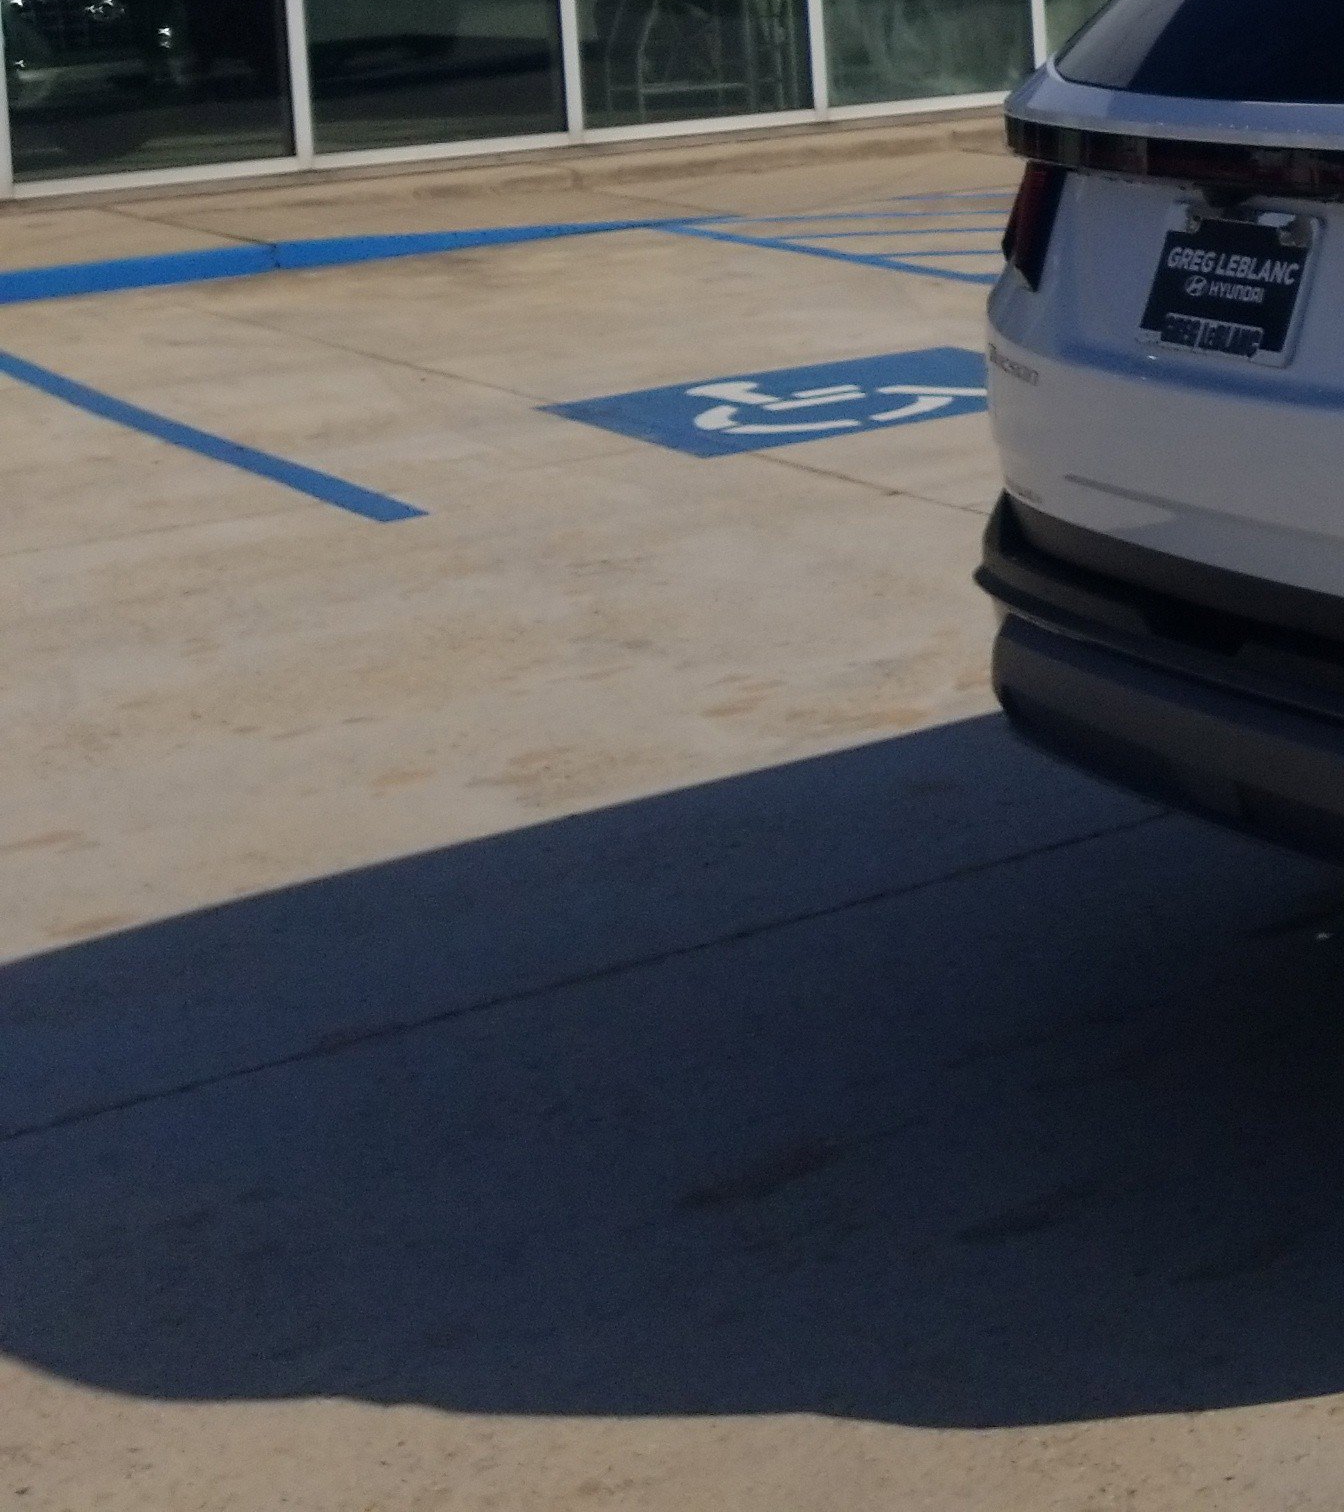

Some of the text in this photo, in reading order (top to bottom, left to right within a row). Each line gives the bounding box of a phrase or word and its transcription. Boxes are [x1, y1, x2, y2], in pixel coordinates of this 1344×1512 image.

[1166, 246, 1300, 286] GREG LEBLANC
[1207, 281, 1265, 304] HYUNDAI
